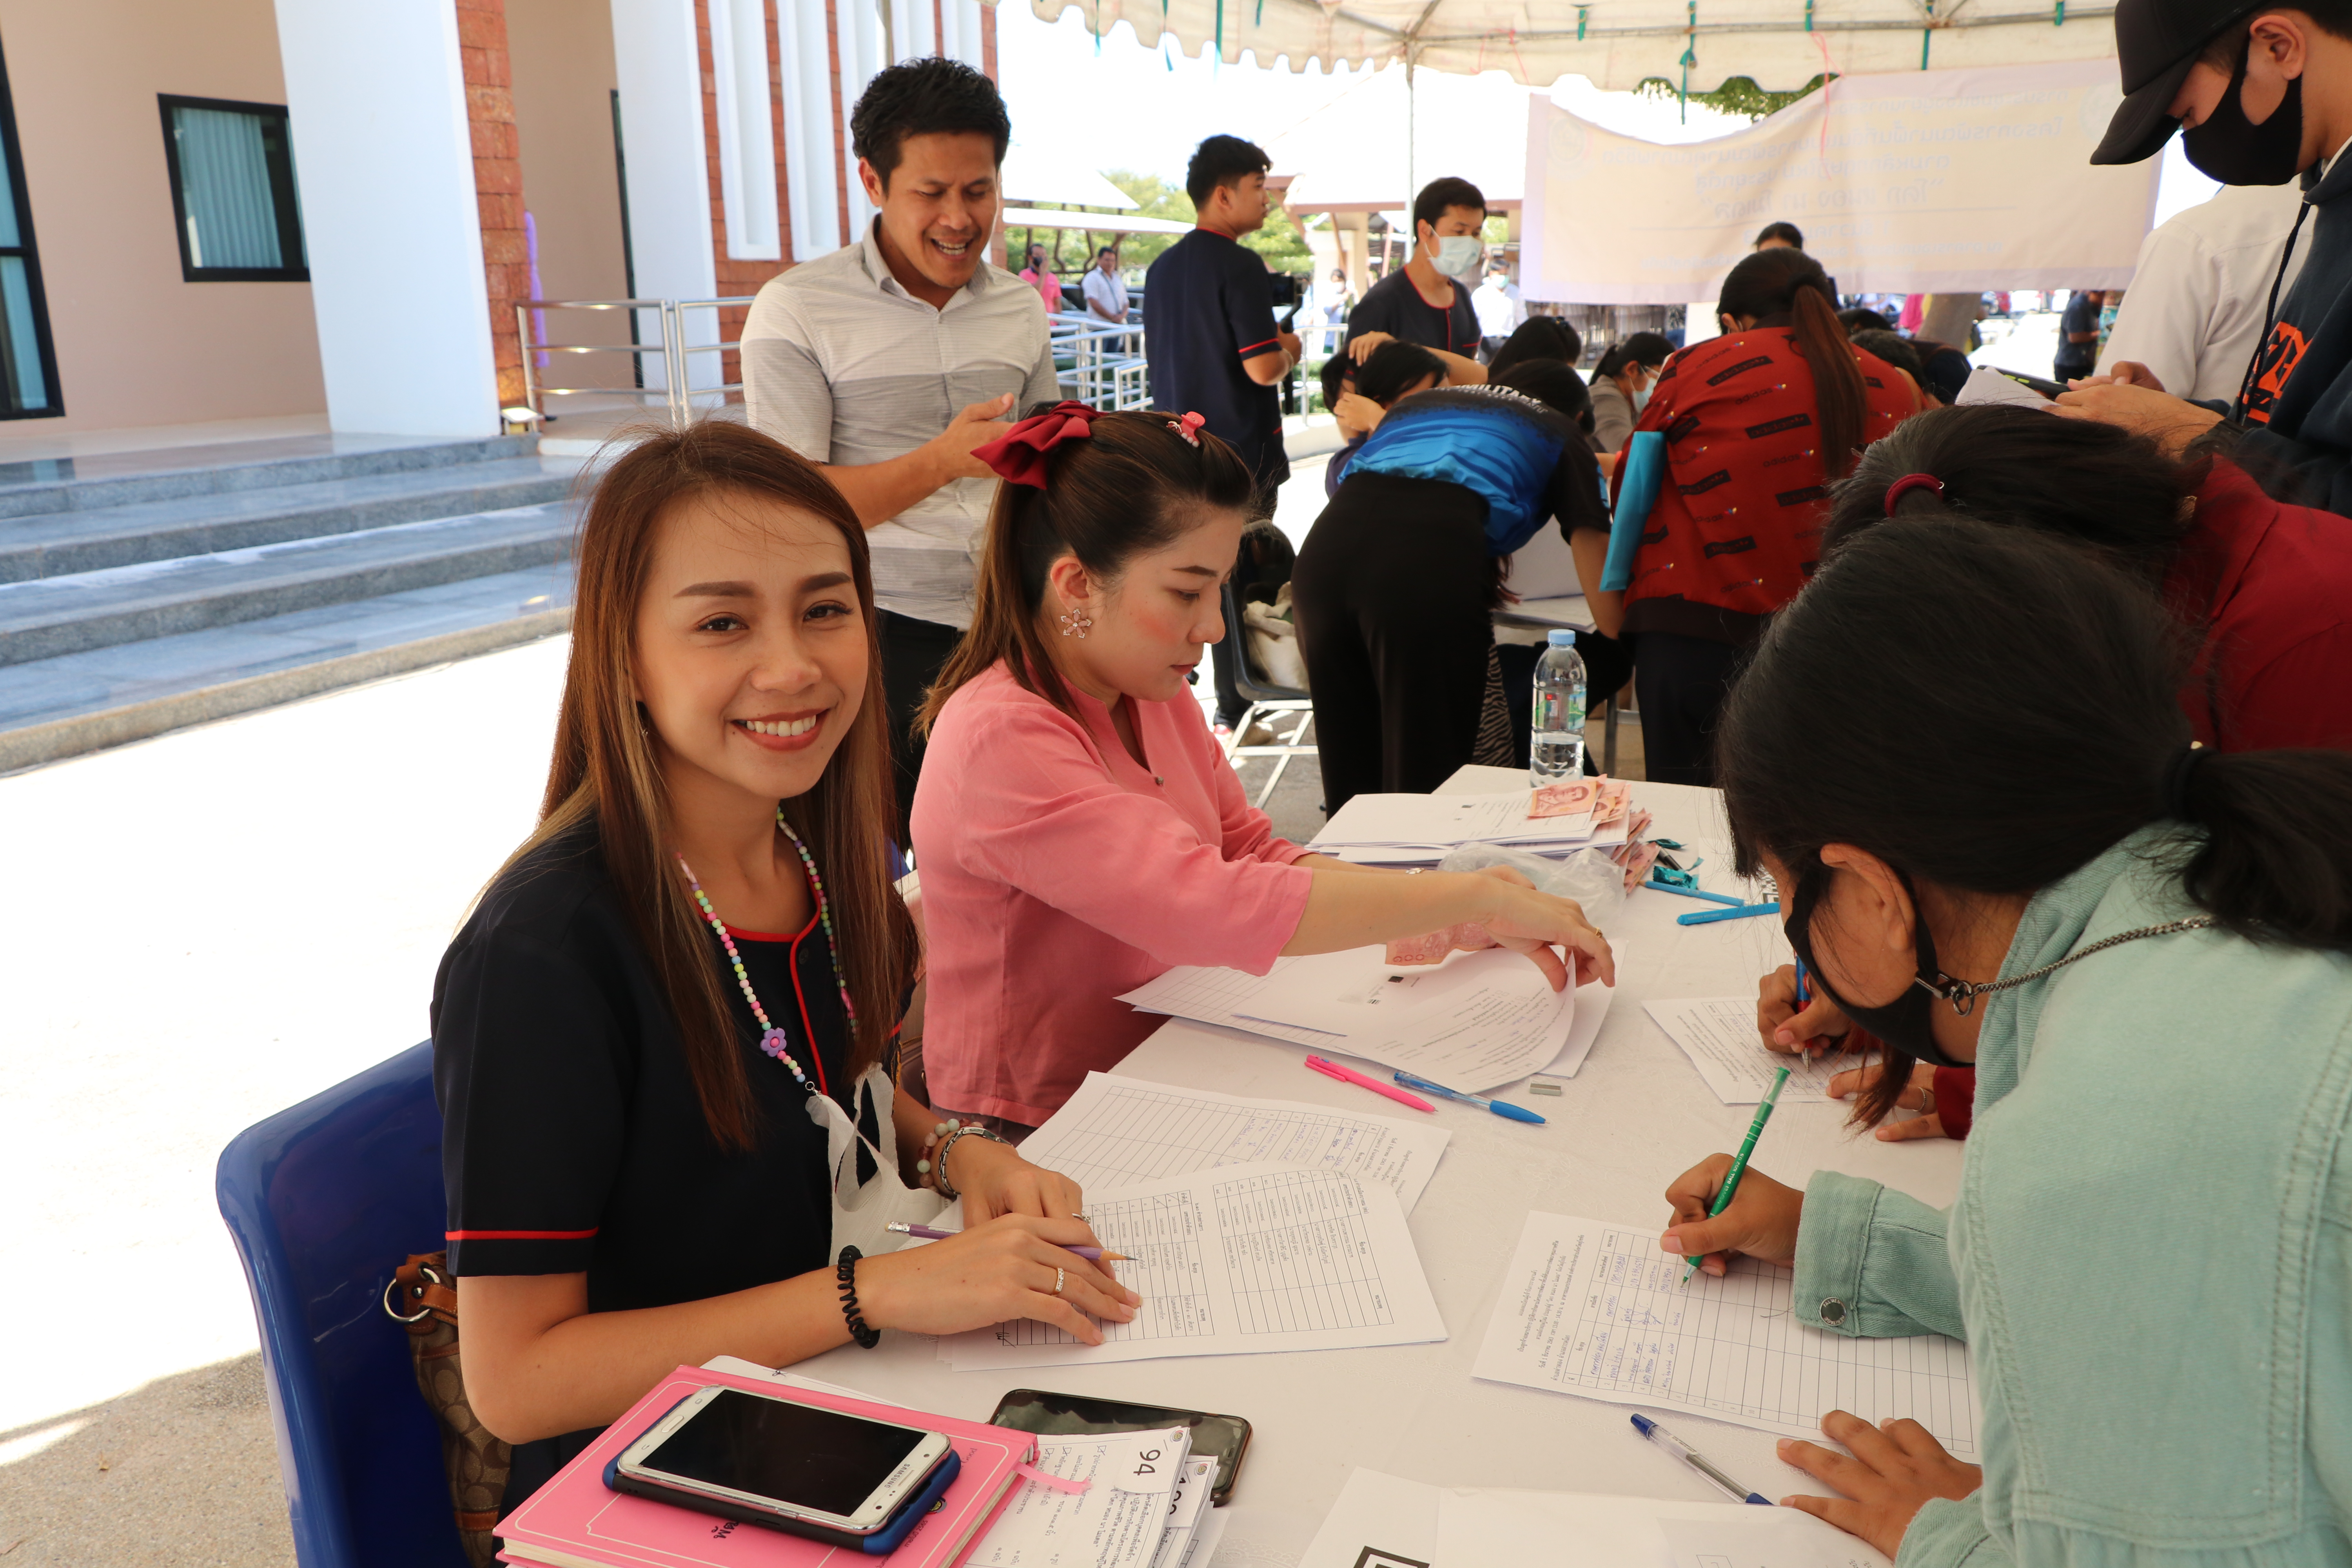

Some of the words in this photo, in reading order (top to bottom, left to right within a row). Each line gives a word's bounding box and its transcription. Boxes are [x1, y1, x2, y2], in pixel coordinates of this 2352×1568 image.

[1712, 359, 1754, 385] adidas
[1735, 387, 1773, 405] adidas
[1750, 420, 1793, 437] adidas
[1763, 453, 1800, 468] adidas
[1183, 1211, 1192, 1235] เลขประจำตัวสอบ
[1191, 1262, 1199, 1273] ชื่อ-สกุล
[1342, 1183, 1353, 1208] เลขประจำตัวสอบ
[1374, 1294, 1383, 1309] หมายเหตุ
[1541, 1345, 1551, 1357] ธันวาคม
[1556, 1335, 1570, 1358] อำเภอสวรรคโลก
[963, 1447, 977, 1464] Good
[1131, 1449, 1162, 1476] 94
[884, 1462, 911, 1489] SAMSUNG
[1059, 1455, 1086, 1498] และไม่สวมแดำ
[1013, 1456, 1051, 1514] สำเนาบัระจำตัวประชาชน
[1038, 1494, 1052, 1506] (ถ้ามี)
[1054, 1501, 1065, 1513] ขนาด
[1101, 1507, 1111, 1520] หนอง
[918, 1520, 928, 1532] 2565
[990, 1552, 1002, 1563] ฉบับ
[1009, 1555, 1021, 1565] ฉบับ
